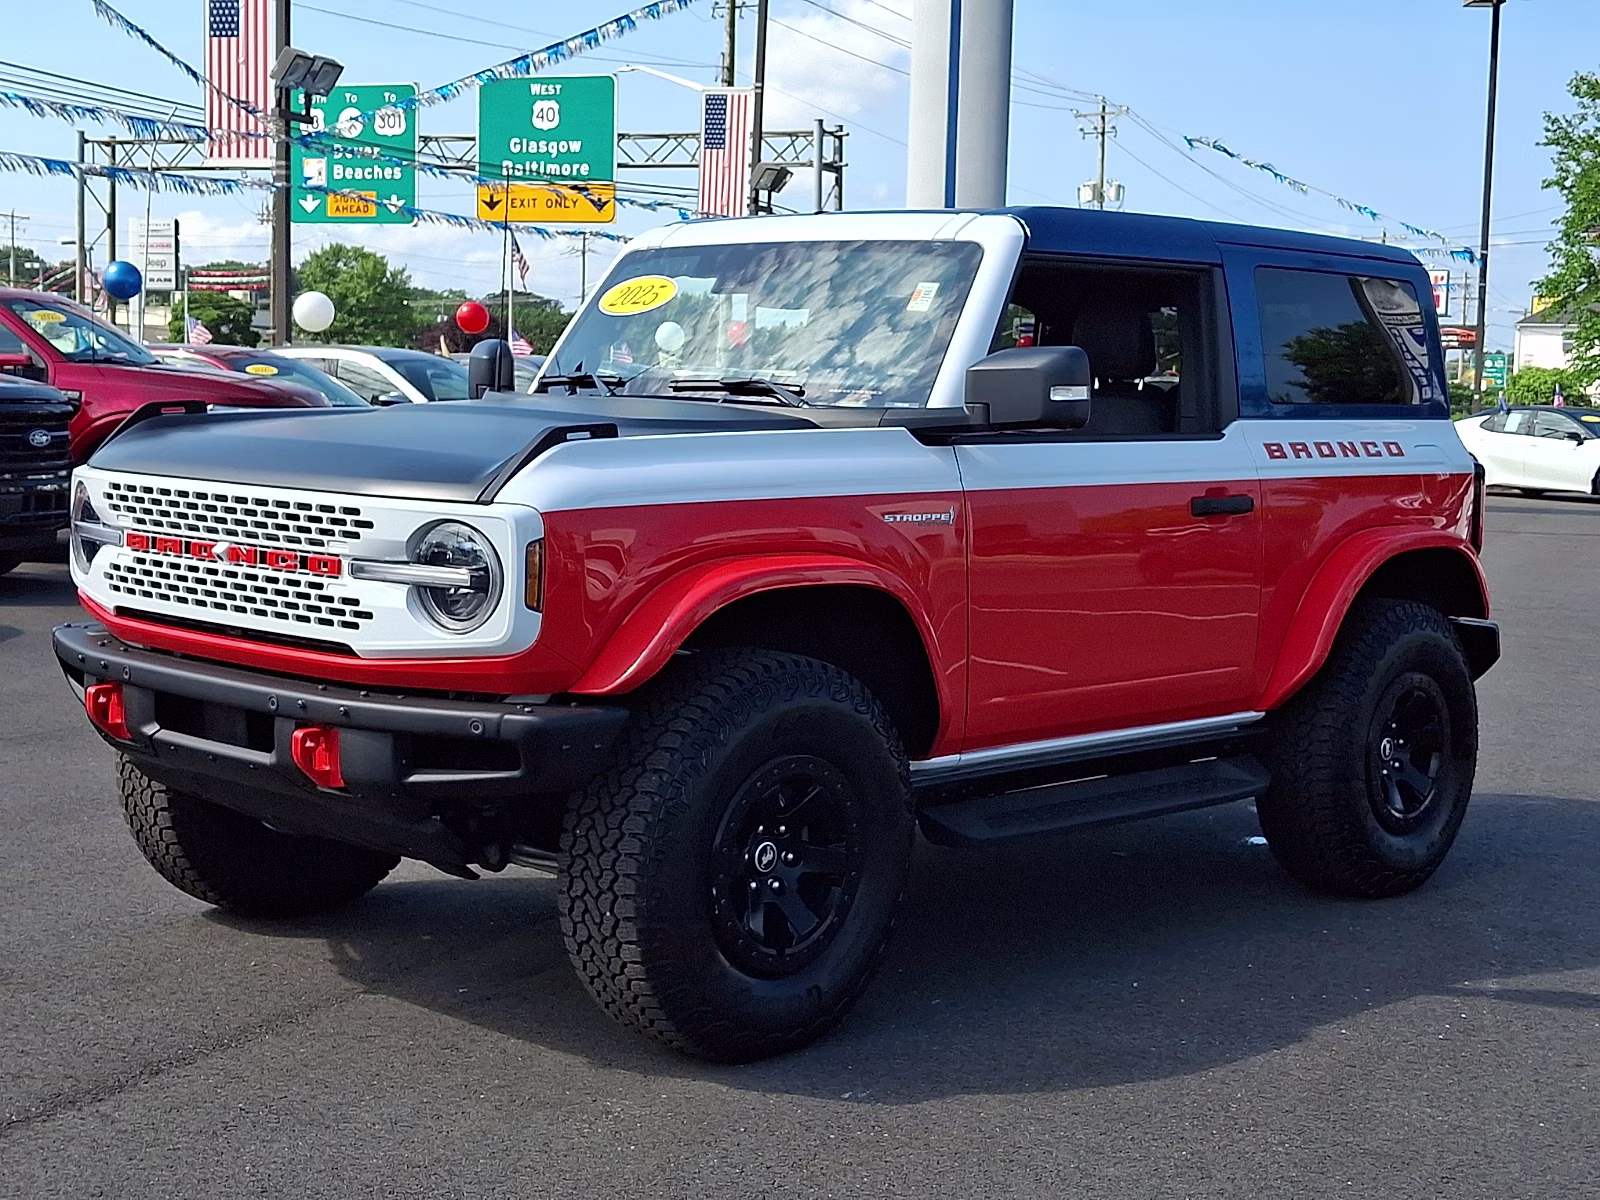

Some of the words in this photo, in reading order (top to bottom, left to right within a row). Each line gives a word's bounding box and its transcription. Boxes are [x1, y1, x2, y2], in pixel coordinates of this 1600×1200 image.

[530, 83, 562, 96] WEST
[535, 106, 556, 123] 40
[509, 137, 582, 159] Glasgow
[333, 164, 402, 180] Beaches
[501, 159, 590, 176] Baltimore
[335, 204, 370, 214] AHEAD
[510, 197, 538, 209] EXIT
[545, 197, 579, 209] ONLY
[608, 284, 667, 307] 2025
[1262, 441, 1406, 460] BRONCO
[883, 512, 951, 523] STROPPE
[126, 532, 342, 577] BRONCO
